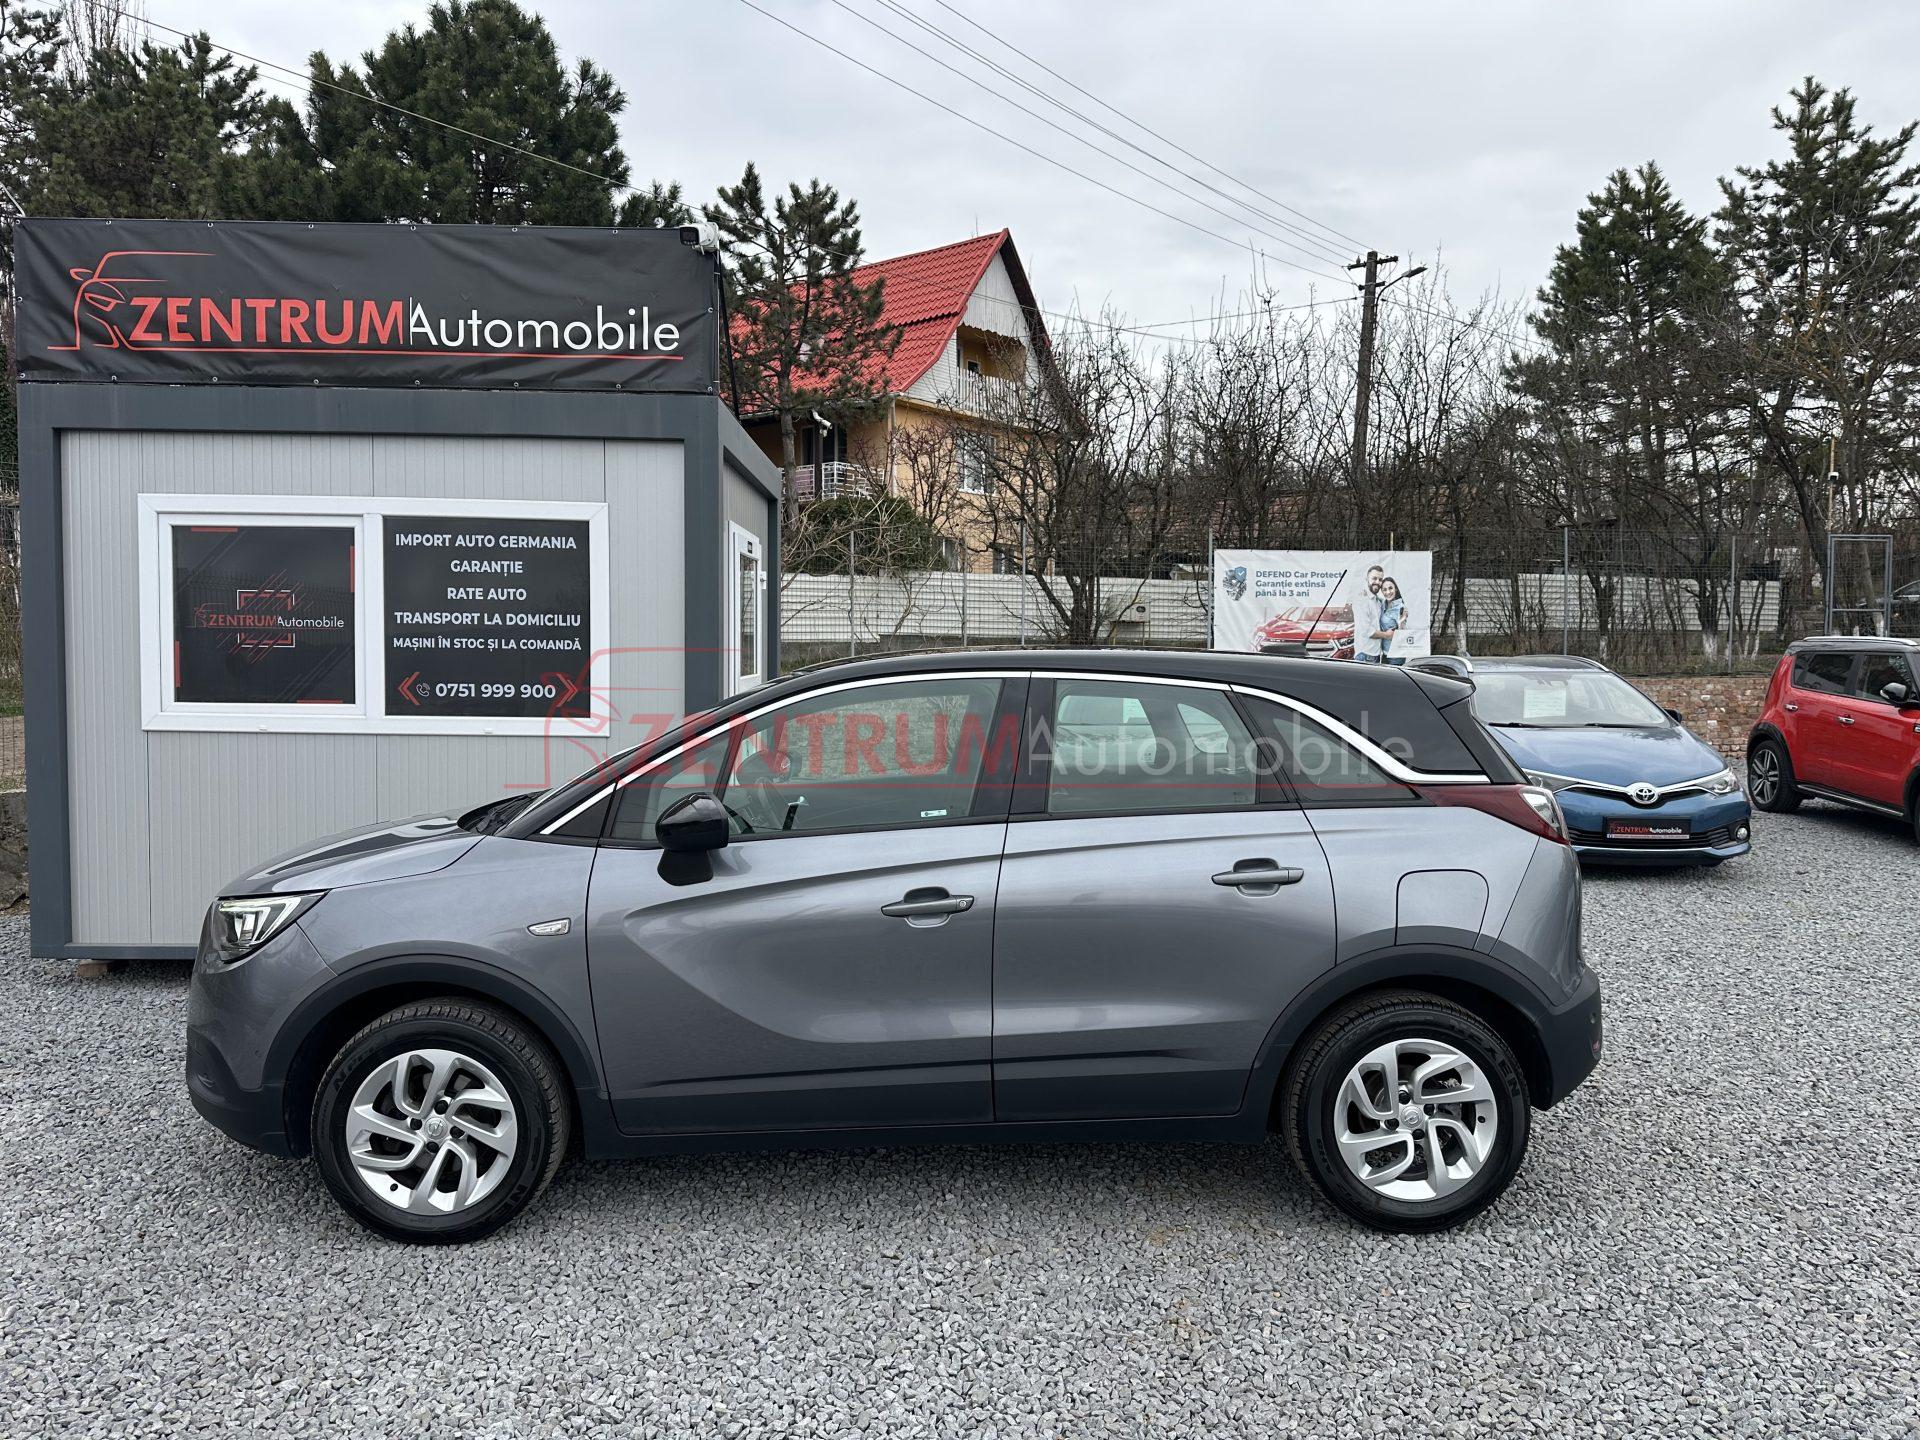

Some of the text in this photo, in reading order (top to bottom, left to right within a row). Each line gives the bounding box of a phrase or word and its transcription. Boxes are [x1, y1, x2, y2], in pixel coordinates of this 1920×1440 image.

[129, 296, 680, 352] ZENTRUM Automobile
[395, 533, 577, 550] IMPORT AUTO GERMANIA
[450, 560, 524, 577] GARANȚIE
[1255, 570, 1292, 578] DEFEND
[1310, 571, 1343, 579] Protect
[1255, 579, 1293, 588] Garanție
[447, 587, 527, 601] RATE AUTO
[1278, 589, 1287, 597] la
[1288, 589, 1295, 597] 3
[1296, 589, 1310, 597] ani
[208, 614, 345, 629] ZENTRUM Automobile
[394, 611, 581, 627] TRANSPORT LA DOMICILIU
[393, 635, 582, 652] MAȘINI ÎN STOC ȘI LA COMANDĂ
[435, 683, 556, 699] 0751 999 900
